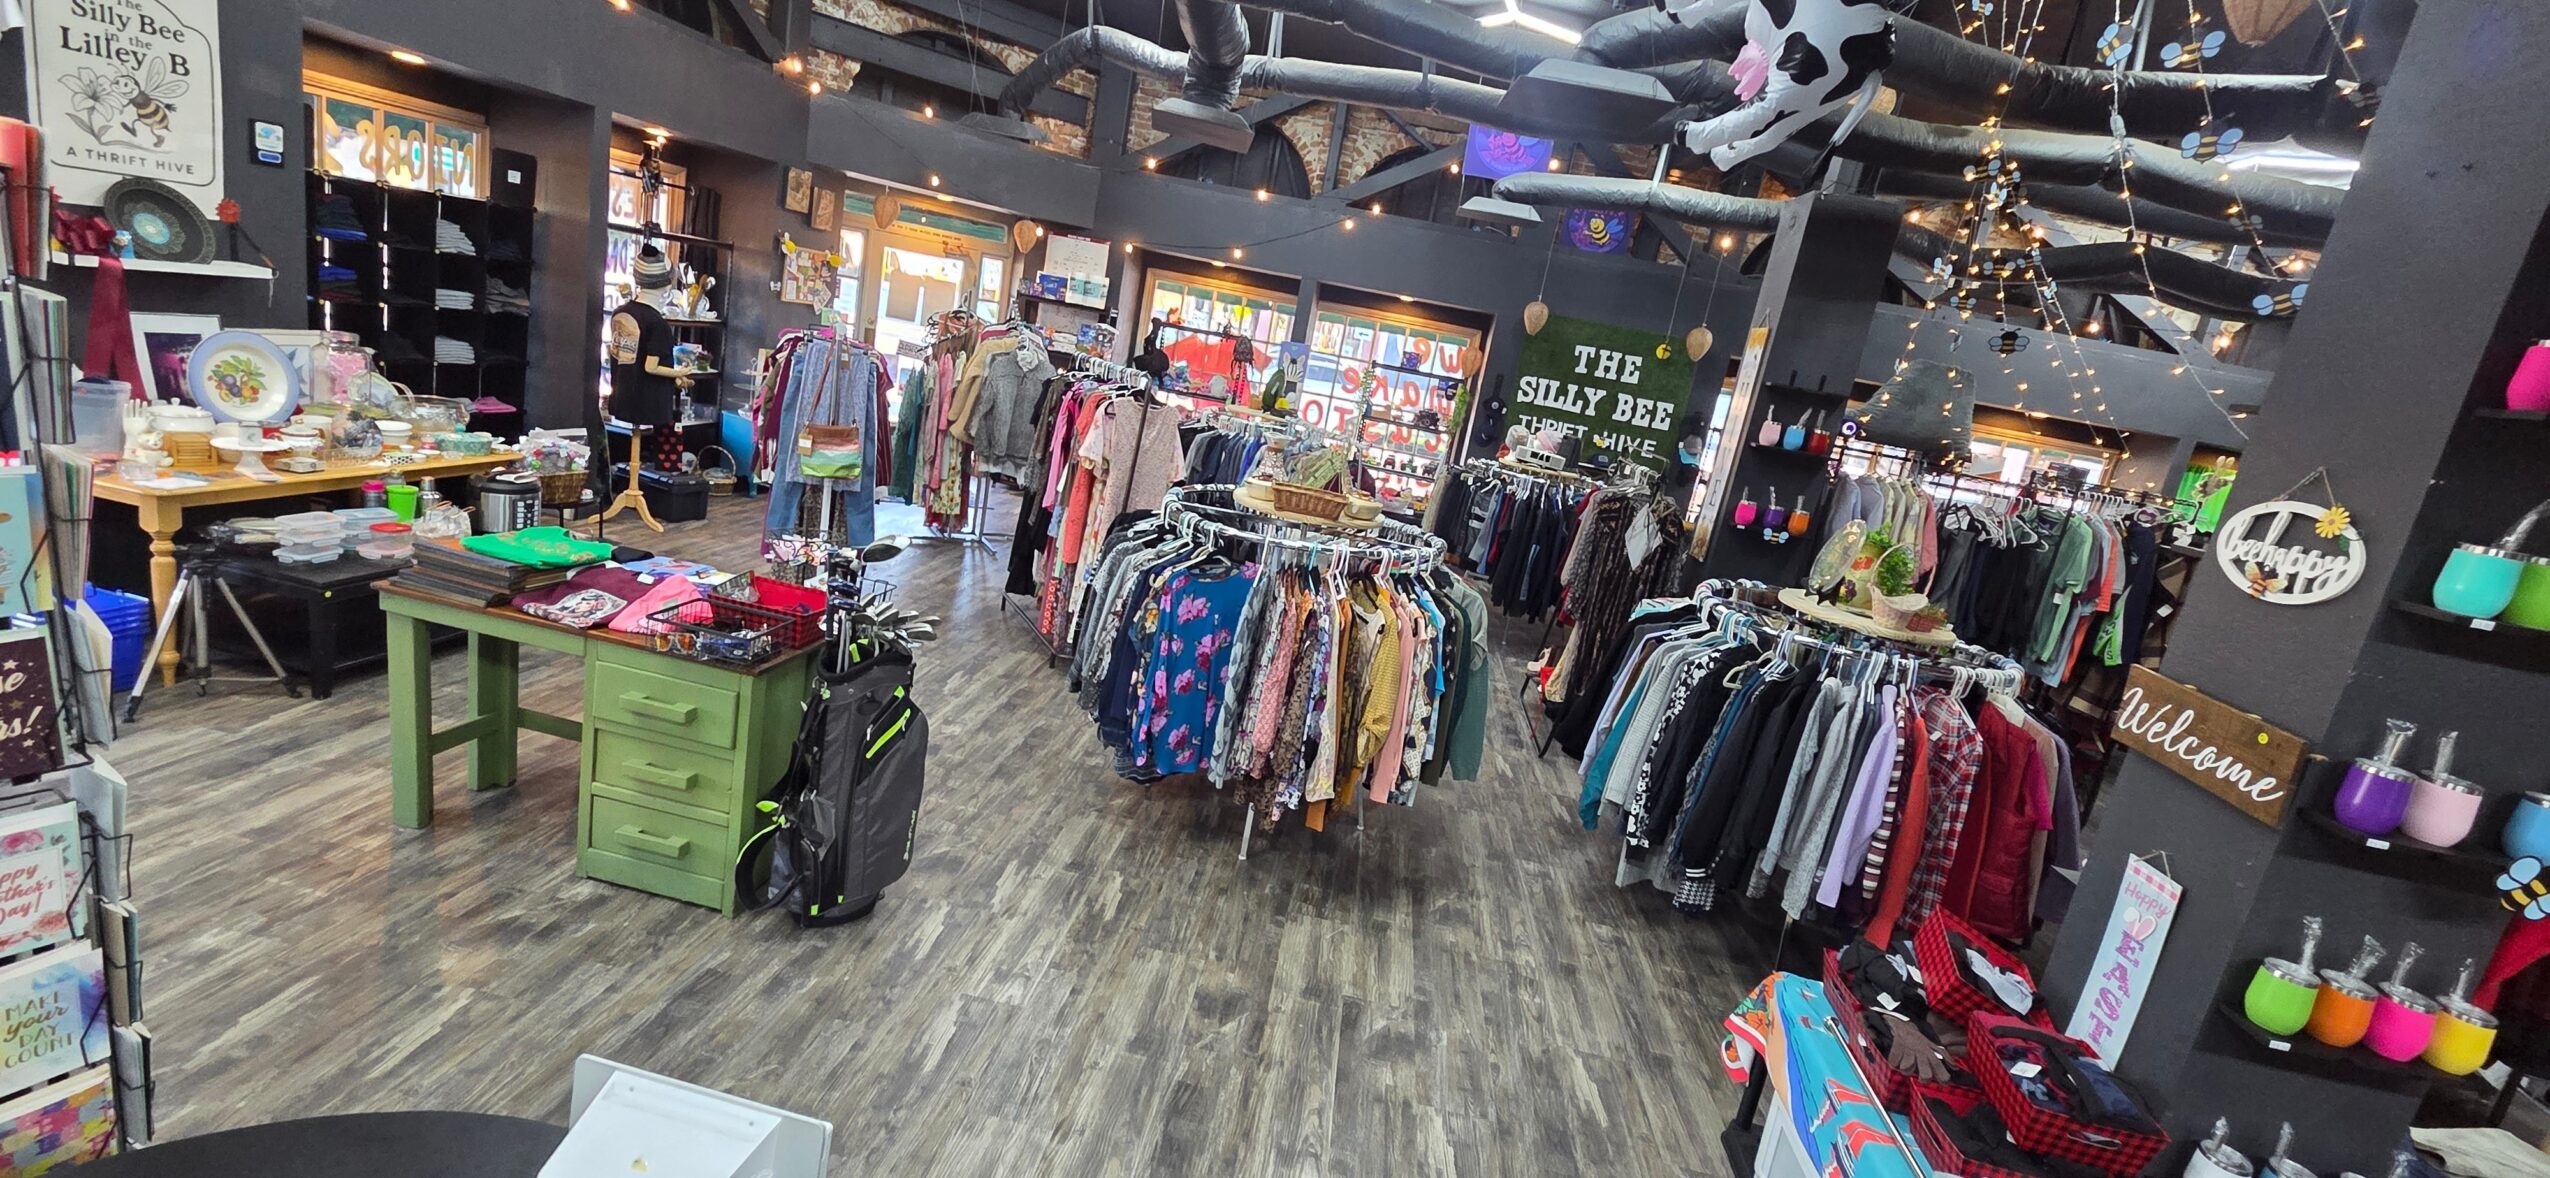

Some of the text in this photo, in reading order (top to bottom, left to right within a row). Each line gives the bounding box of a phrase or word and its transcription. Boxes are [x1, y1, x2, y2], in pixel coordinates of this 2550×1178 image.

[71, 0, 185, 43] Silly Bee
[104, 29, 152, 50] in the
[59, 25, 191, 77] Lilley B
[66, 146, 195, 174] A THRIFT HIVE
[1574, 344, 1643, 384] THE
[1516, 375, 1675, 431] SILLY BEE
[1518, 414, 1657, 458] THRIFT HIVE
[2117, 687, 2285, 802] Welcome
[0, 876, 55, 902] ther's
[2124, 881, 2172, 919] Happy
[2, 1005, 70, 1043] your
[18, 1022, 60, 1049] DAY
[4, 1031, 74, 1069] COUNT
